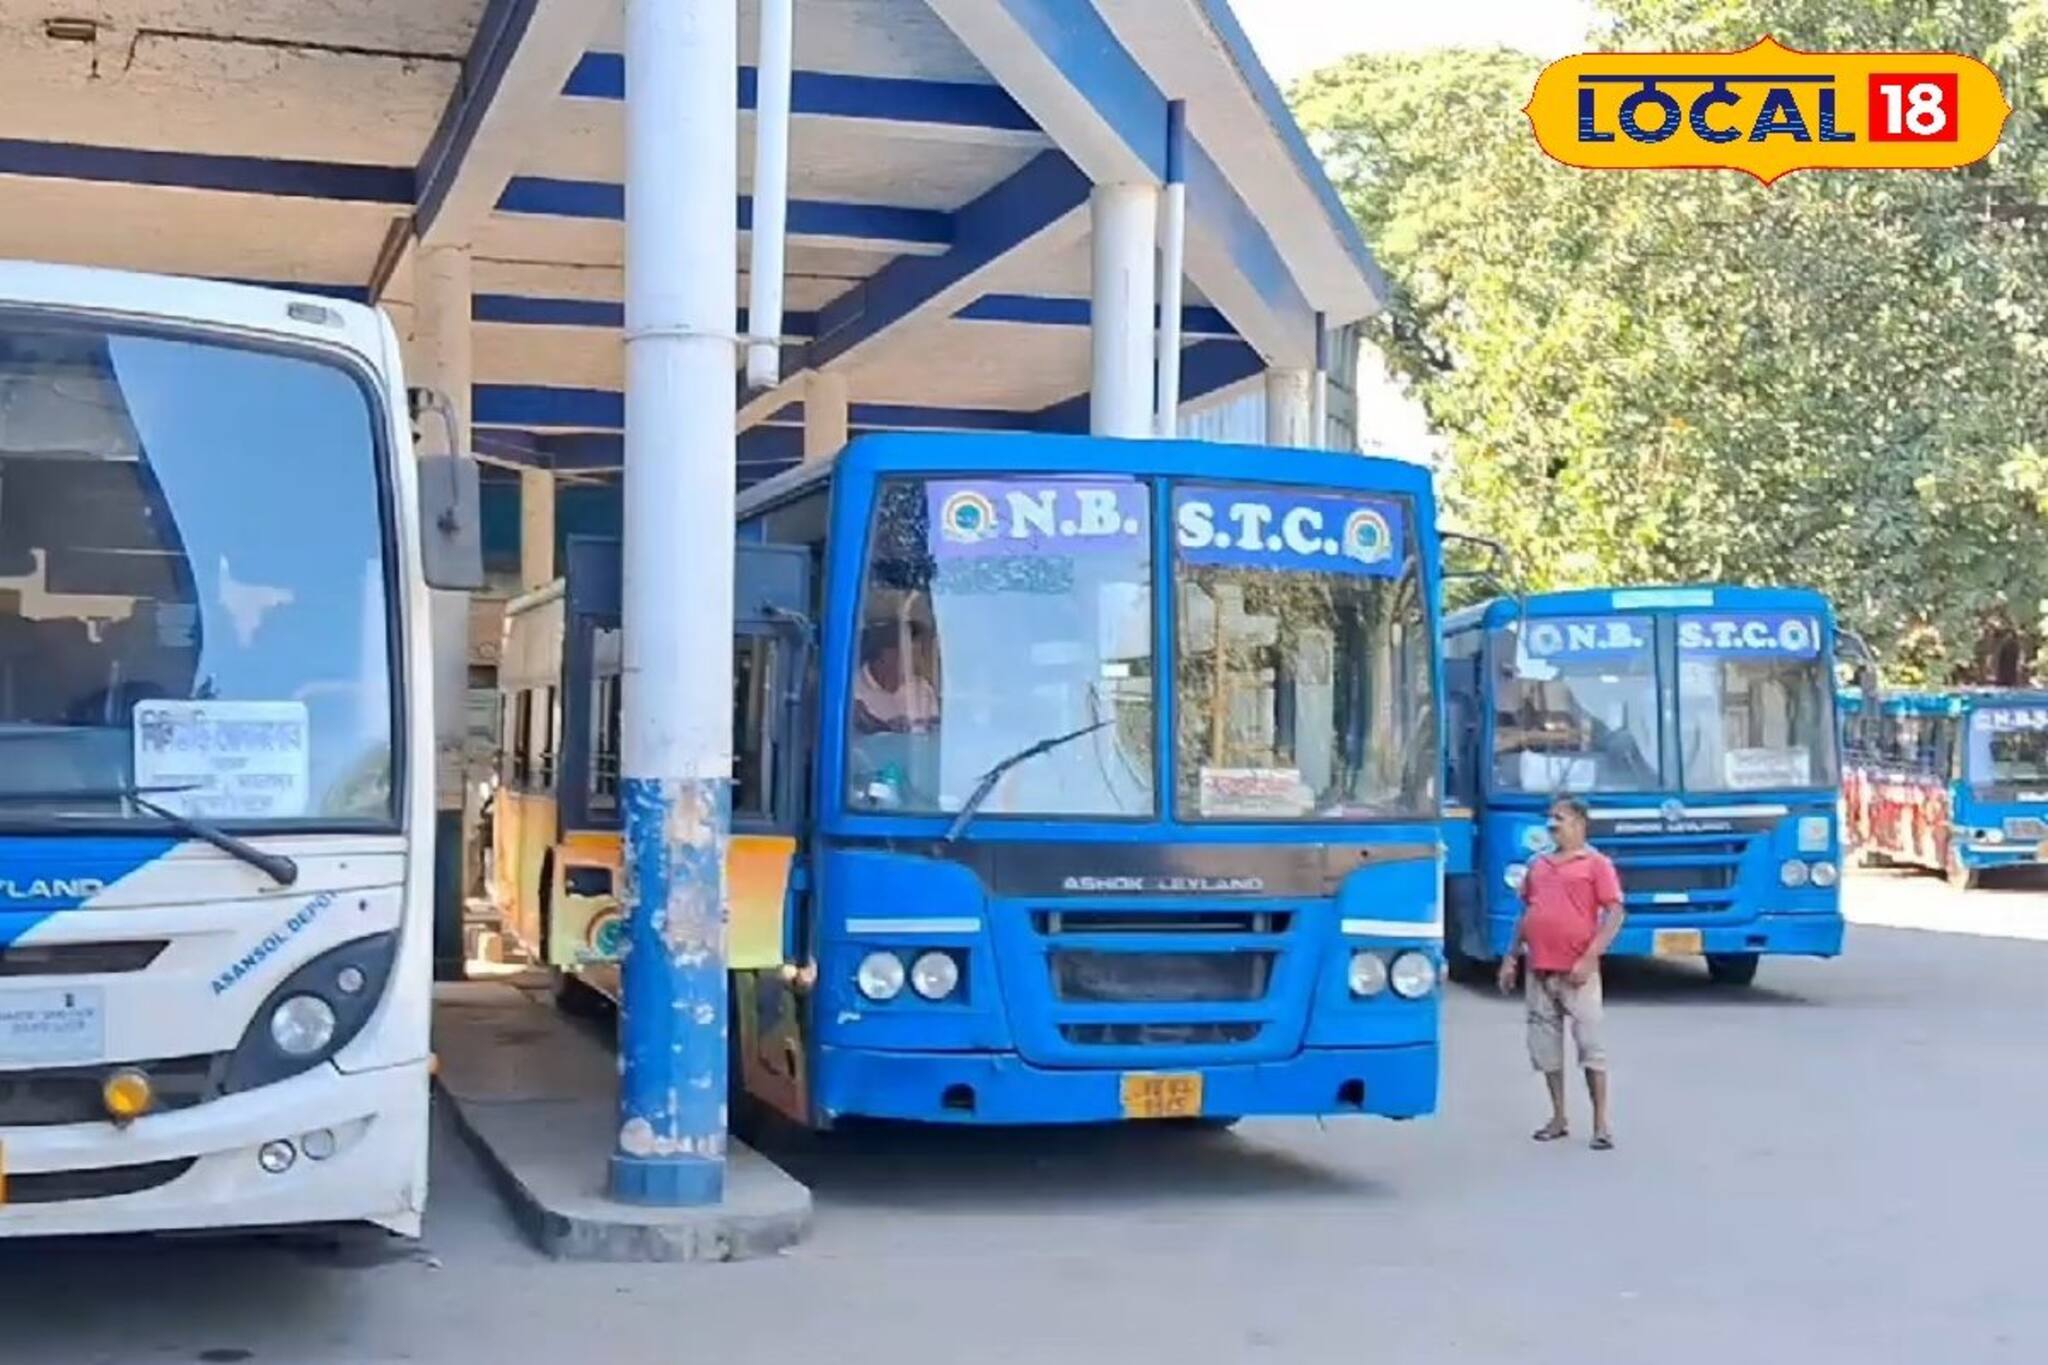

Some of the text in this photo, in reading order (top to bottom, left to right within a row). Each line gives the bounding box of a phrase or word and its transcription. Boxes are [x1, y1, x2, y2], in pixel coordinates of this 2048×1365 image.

[1007, 489, 1339, 556] N.B. S.T.C.
[1567, 621, 1778, 649] N.B. S.T.C.
[1063, 876, 1265, 891] ASHOK LEYLAND
[211, 889, 337, 996] ASANSOL DEPOT
